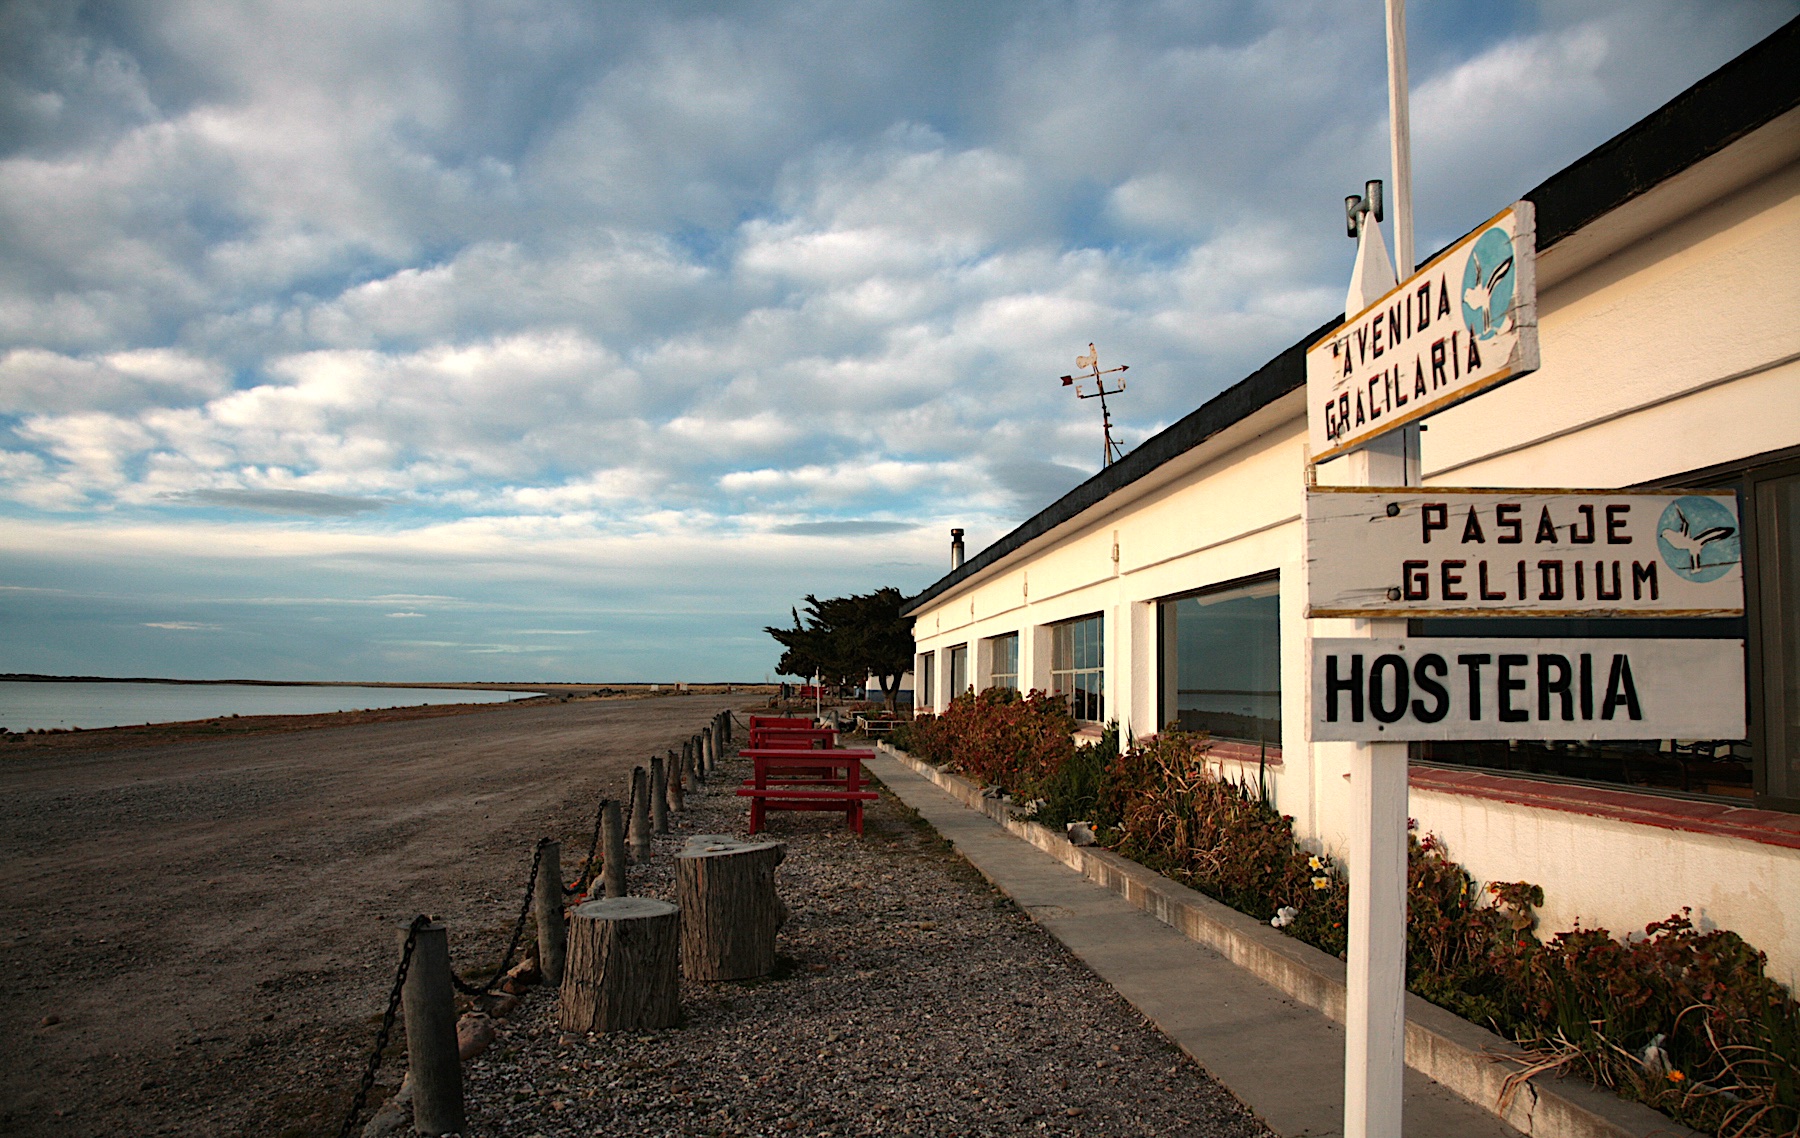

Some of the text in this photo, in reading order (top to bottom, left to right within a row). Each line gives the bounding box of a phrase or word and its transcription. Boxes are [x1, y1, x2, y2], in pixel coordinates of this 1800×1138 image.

[1343, 272, 1450, 378] AVENIDA
[1325, 323, 1482, 441] GRACILARIA
[1422, 503, 1633, 545] PASAJE
[1402, 560, 1659, 602] GELIDIUM
[1326, 653, 1642, 724] HOSTERIA
